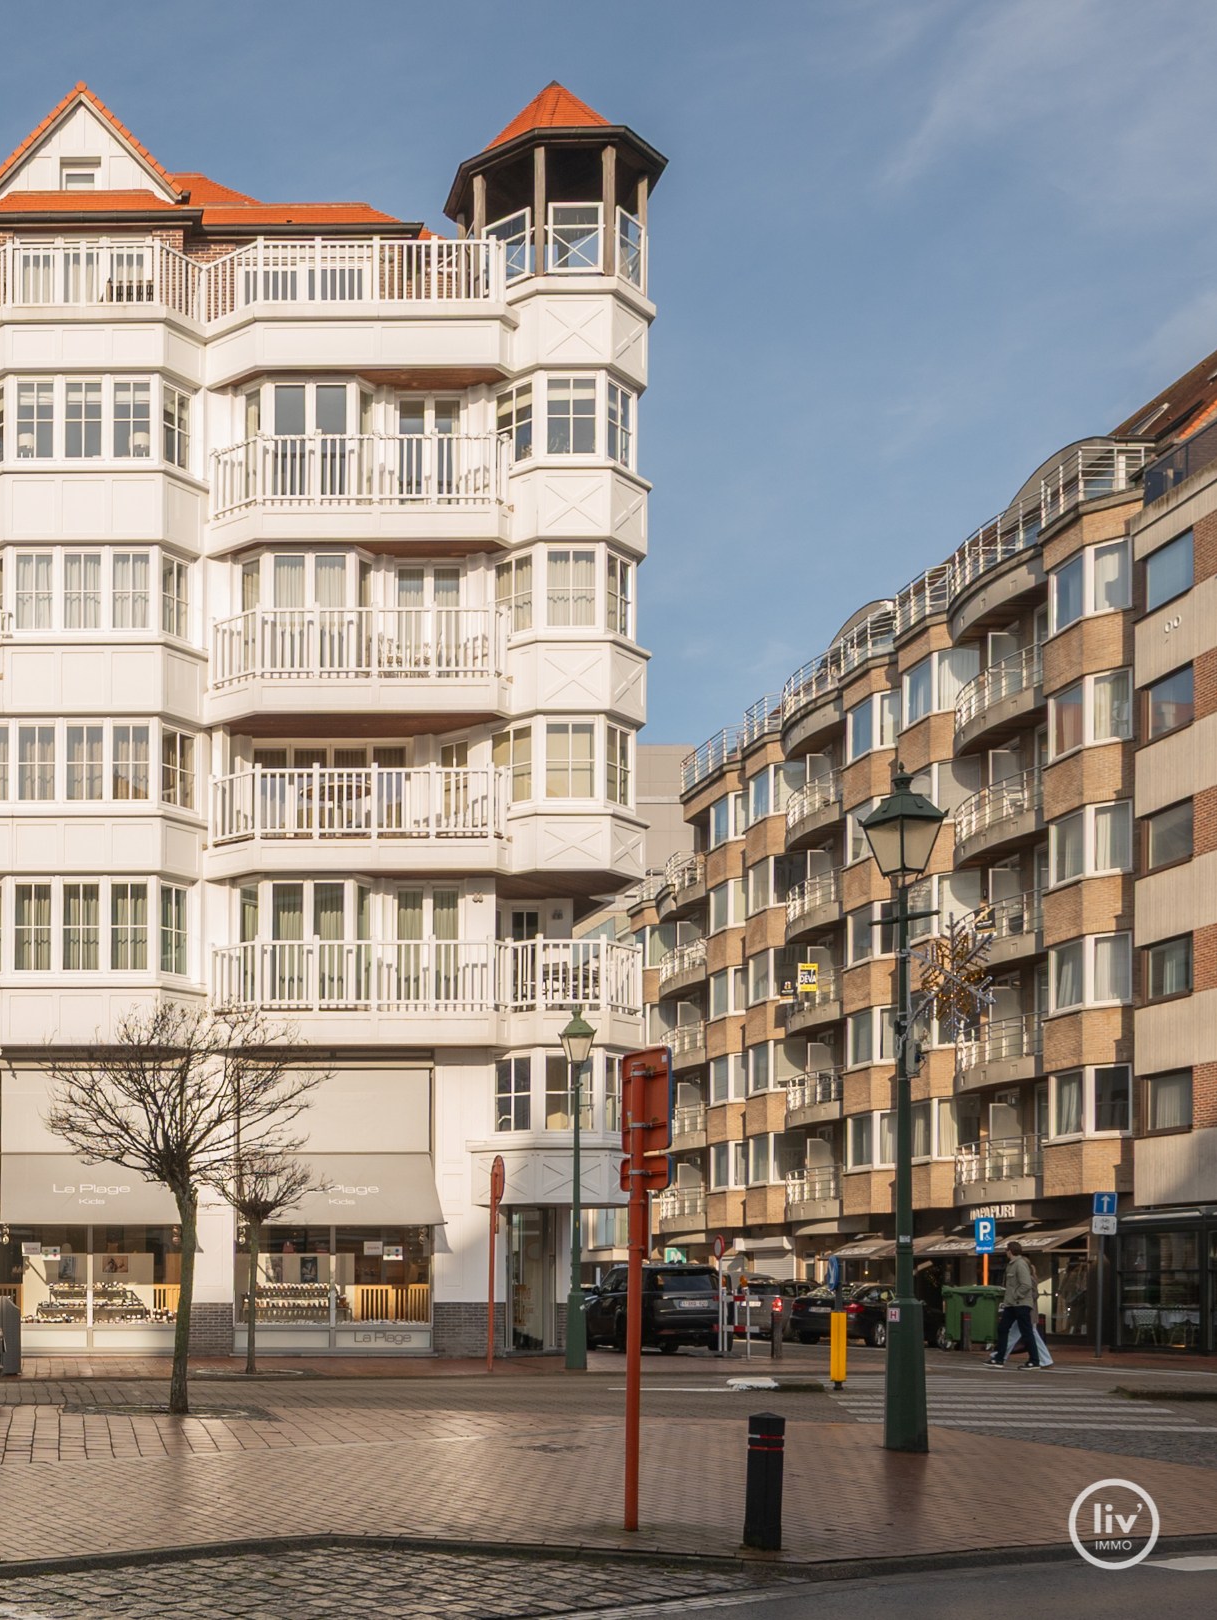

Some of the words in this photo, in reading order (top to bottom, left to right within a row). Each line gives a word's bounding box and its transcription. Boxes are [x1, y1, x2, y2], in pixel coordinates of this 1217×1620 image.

[52, 1183, 76, 1193] La
[79, 1183, 131, 1195] Plage
[328, 1184, 380, 1196] Plage
[78, 1197, 106, 1205] Kids
[979, 1221, 991, 1241] P
[354, 1331, 371, 1343] La
[375, 1331, 411, 1345] Plage
